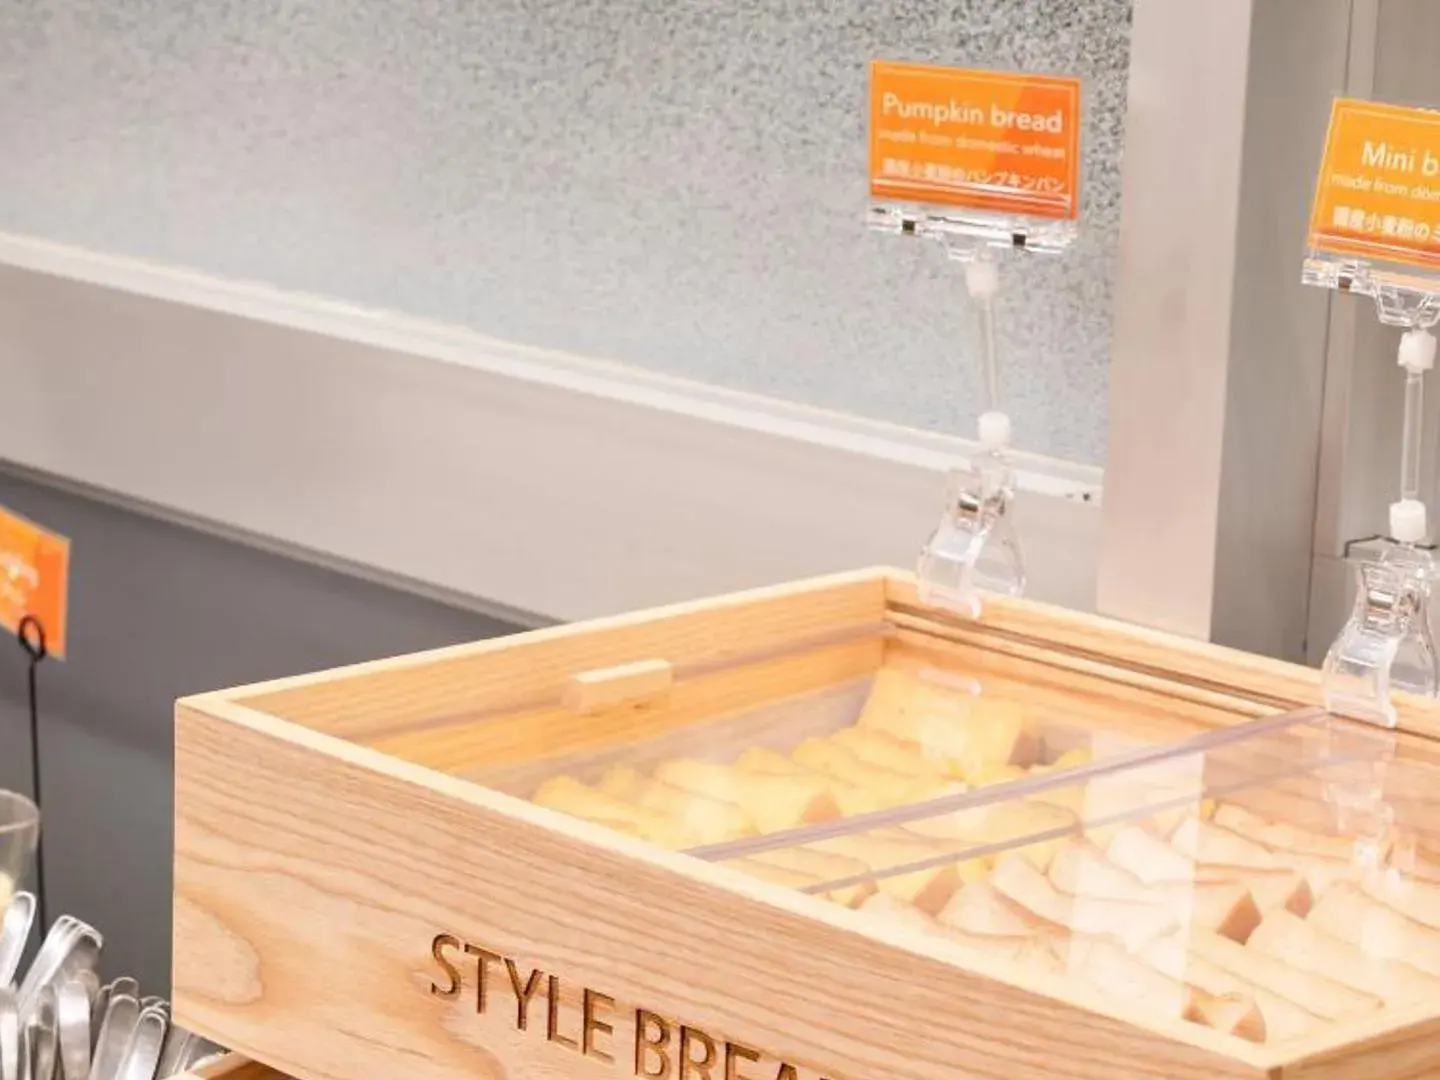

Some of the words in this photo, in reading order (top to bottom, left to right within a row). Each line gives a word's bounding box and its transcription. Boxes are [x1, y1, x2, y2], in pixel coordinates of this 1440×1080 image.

[882, 91, 984, 127] Pumpkin
[990, 103, 1063, 133] bread
[1362, 140, 1417, 172] Mini
[430, 933, 616, 1063] STYLE
